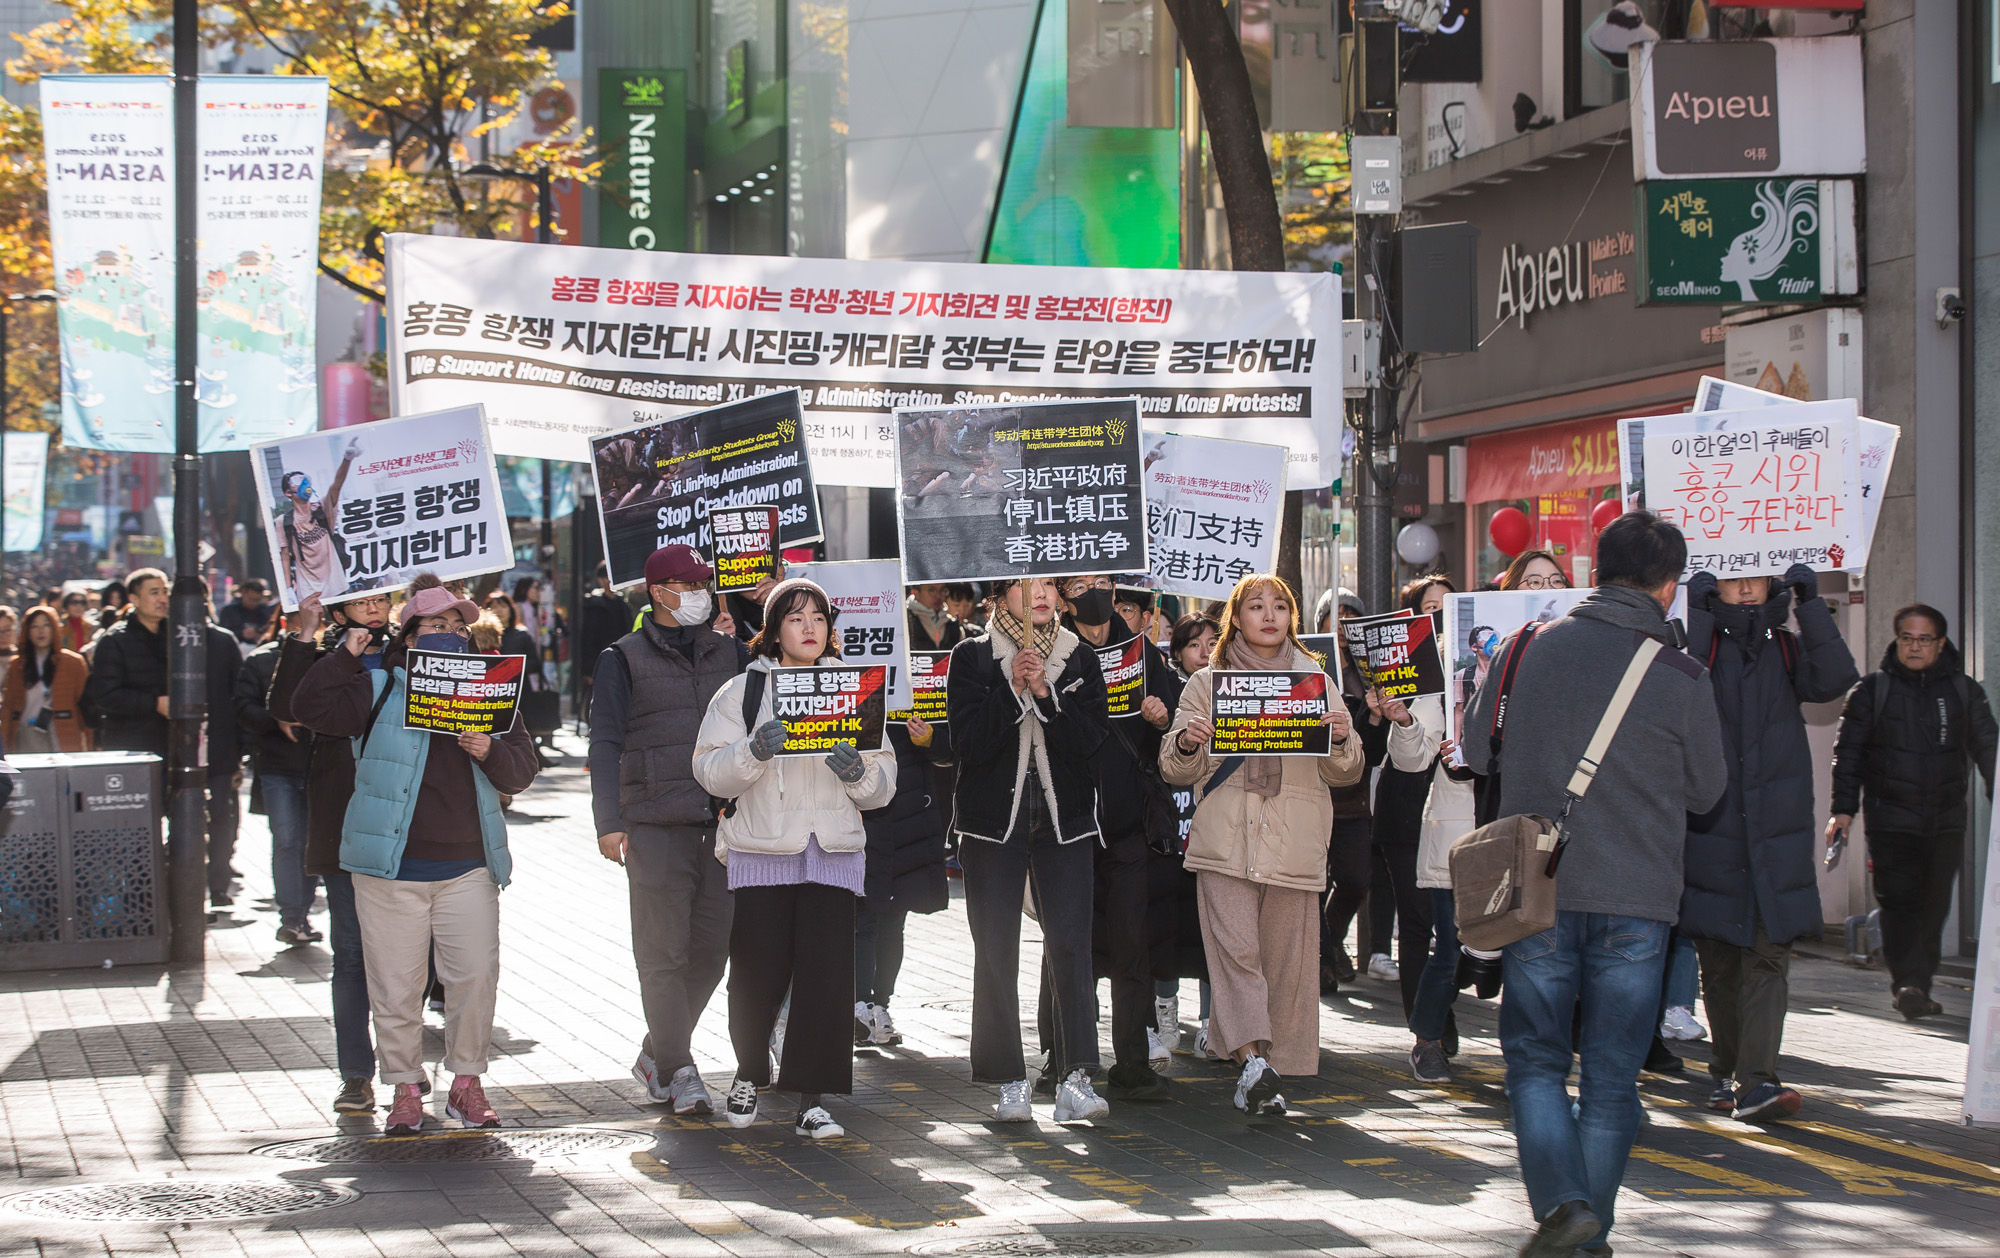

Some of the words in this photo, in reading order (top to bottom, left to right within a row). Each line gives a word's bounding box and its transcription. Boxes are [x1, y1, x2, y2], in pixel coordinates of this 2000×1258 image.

[1744, 147, 1768, 160] 어퓨
[629, 113, 656, 220] Nature
[1659, 190, 1709, 221] 서민호
[1680, 218, 1713, 238] 헤어
[1592, 235, 1618, 262] Make
[1778, 277, 1815, 294] Hair
[552, 276, 600, 303] 홍콩
[607, 278, 679, 307] 항쟁을
[685, 284, 782, 312] 지지하는
[900, 292, 1000, 319] 기자회견
[1005, 295, 1031, 320] 및
[1035, 295, 1172, 324] 홍보전(행진)
[404, 301, 473, 338] 홍콩
[481, 313, 554, 350] 항쟁
[561, 320, 711, 362] 지지한다!
[718, 328, 936, 369] 시진핑·캐리람
[942, 336, 1045, 372] 정부는
[1054, 339, 1160, 374] 탄압을
[1168, 338, 1316, 374] 중단하라!
[410, 355, 436, 376] We
[437, 355, 514, 378] Support
[516, 361, 565, 385] Hong
[566, 370, 615, 392] Kong
[617, 377, 723, 402] Resistance!
[727, 383, 745, 401] Xi
[1130, 394, 1172, 413] ong
[1175, 394, 1220, 413] Kong
[1222, 393, 1303, 413] Protests!
[831, 425, 853, 439] 11시
[995, 425, 1104, 443] 劳动者连带学生团体
[1672, 431, 1759, 458] 이한열의
[1762, 426, 1829, 453] 후배들이
[656, 453, 687, 468] Workers'
[687, 444, 722, 460] Solidarity
[723, 437, 755, 450] Students
[756, 431, 778, 443] Group
[876, 449, 894, 458] 한국
[1567, 430, 1617, 477] SALE
[357, 454, 412, 476] 노동자연대
[413, 446, 457, 464] 학생그룹
[671, 478, 682, 498] Xi
[683, 473, 720, 494] JinPing
[721, 451, 798, 484] Administration!
[1002, 463, 1127, 492] 习近平政府
[1154, 472, 1252, 494] 劳动者连带学生团体
[1673, 461, 1742, 503] 홍콩
[1750, 451, 1821, 493] 시위
[341, 492, 406, 535] 홍콩
[414, 478, 481, 521] 항쟁
[656, 505, 691, 529] Stop
[694, 482, 779, 518] Crackdown
[783, 477, 802, 498] on
[1003, 493, 1129, 527] 停止镇压
[713, 512, 743, 533] 홍콩
[745, 511, 770, 530] 항쟁
[778, 504, 807, 527] ests
[1737, 495, 1844, 534] 규탄한다
[1147, 504, 1263, 548] 我们支持
[350, 521, 487, 578] 지지한다!
[716, 533, 771, 555] 지지한다!
[1004, 531, 1130, 564] 香港抗争
[718, 556, 765, 572] Support
[765, 554, 774, 567] HK
[1681, 551, 1760, 575] 동자연대
[719, 572, 770, 587] Resista
[846, 596, 880, 607] 학생그룹
[843, 627, 895, 656] 항쟁
[1380, 623, 1409, 645] 항쟁
[411, 655, 487, 680] 시진핑은
[1397, 665, 1419, 679] HK
[411, 677, 455, 695] 탄압을
[457, 681, 517, 697] 중단하라!
[776, 672, 815, 694] 홍콩
[819, 671, 860, 692] 항쟁
[1216, 676, 1292, 697] 시진핑은
[409, 705, 430, 717] Stop
[431, 708, 481, 721] Crackdown
[483, 713, 493, 721] on
[410, 694, 419, 703] Xi
[420, 695, 449, 709] JinPing
[451, 699, 514, 710] Administration!
[777, 695, 857, 716] 지지한다!
[1108, 703, 1129, 712] tests
[1216, 699, 1261, 714] 탄압을
[1264, 699, 1326, 714] 중단하라!
[1496, 694, 1508, 728] Canon
[409, 715, 431, 727] Hong
[432, 719, 454, 730] Kong
[456, 723, 492, 733] Protests
[897, 711, 913, 720] Kong
[914, 710, 947, 719] Protests
[1216, 718, 1225, 727] Xi
[1227, 718, 1257, 729] JinPing
[1259, 718, 1325, 727] Administration
[781, 719, 839, 735] Support
[841, 718, 862, 731] HK
[1215, 730, 1236, 740] Stop
[1238, 730, 1289, 738] Crackdown
[1291, 730, 1302, 738] on
[1215, 740, 1238, 751] Hong
[1240, 740, 1262, 751] Kong
[1264, 740, 1303, 749] Protests
